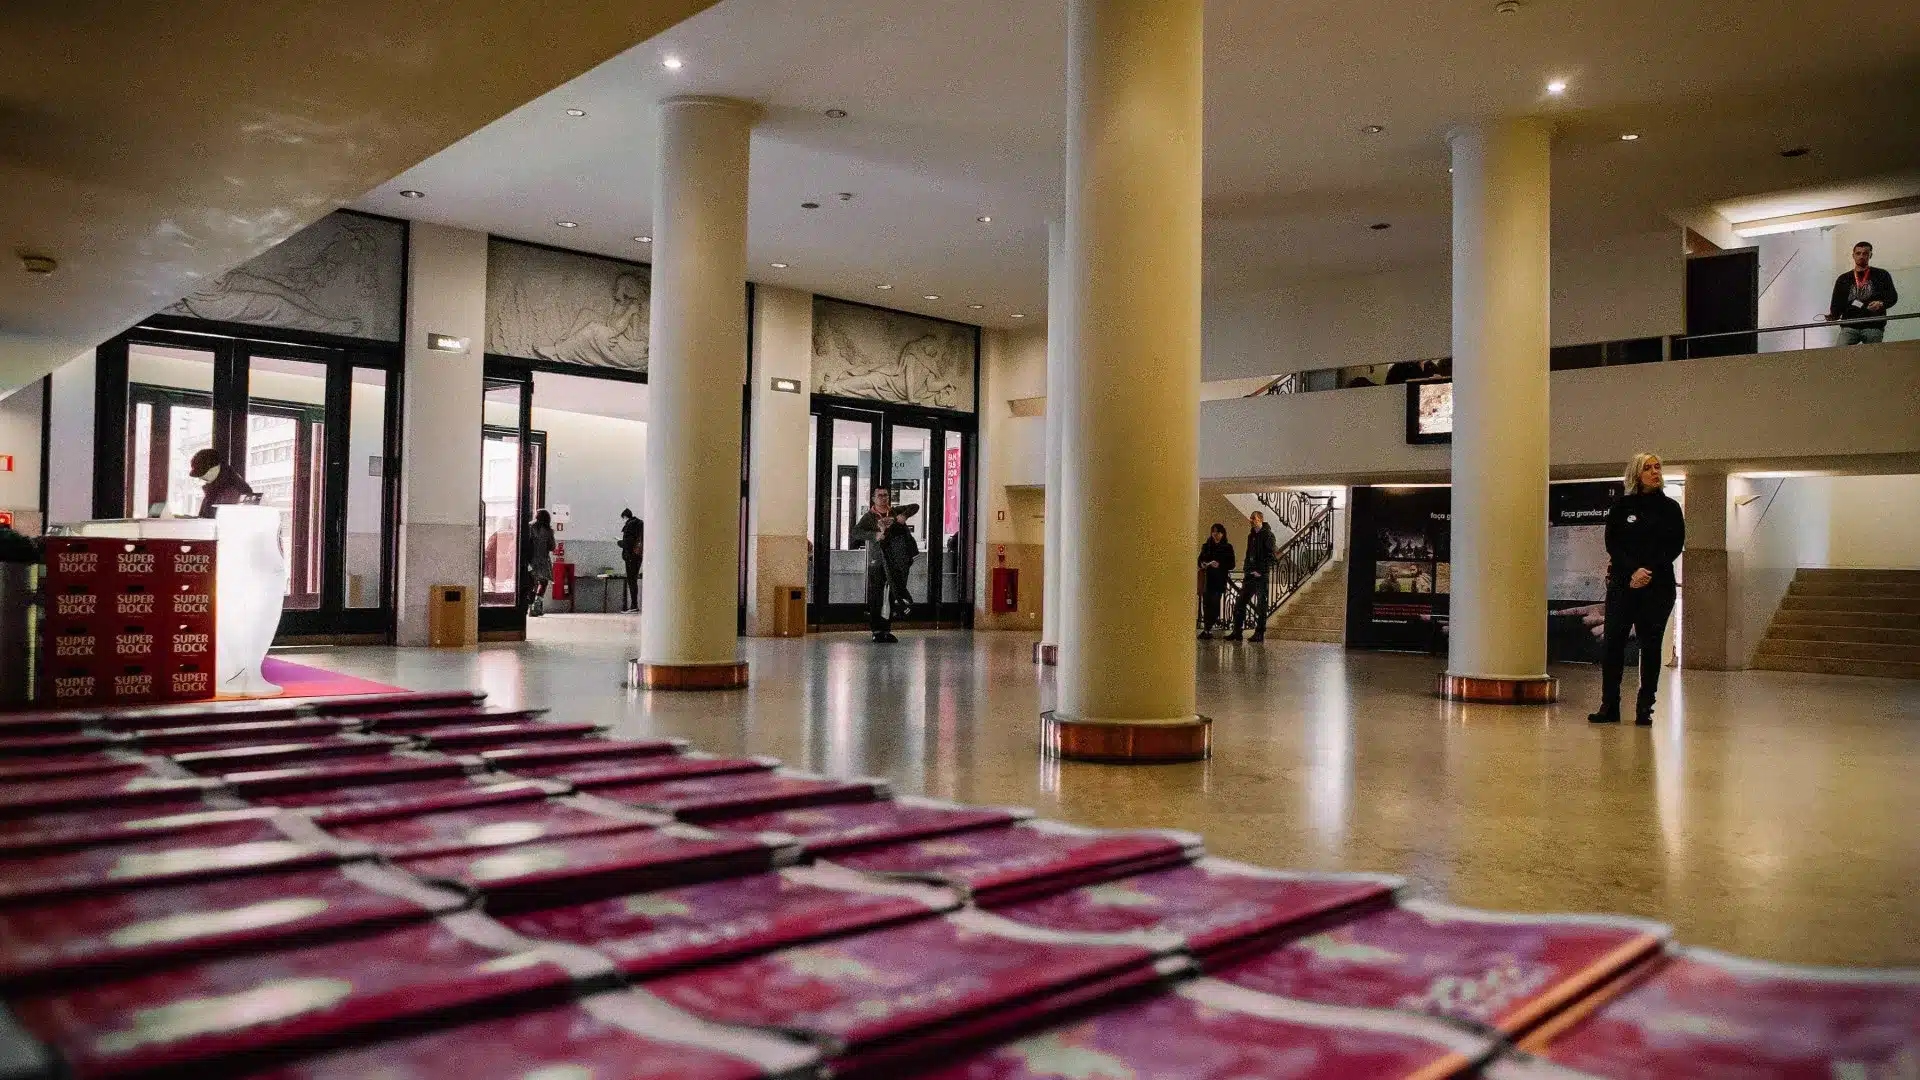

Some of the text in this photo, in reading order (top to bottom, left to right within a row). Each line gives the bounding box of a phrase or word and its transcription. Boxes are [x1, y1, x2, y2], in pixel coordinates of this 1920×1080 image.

[1576, 509, 1602, 518] grandes
[58, 553, 98, 562] SUPER
[118, 554, 155, 563] SUPER
[174, 554, 210, 563] SUPER
[59, 563, 96, 572] BOCK
[118, 564, 153, 572] BOCK
[175, 564, 208, 573] BOCK
[57, 595, 97, 603] SUPER
[117, 595, 154, 603] SUPER
[173, 594, 209, 603] SUPER
[58, 604, 95, 614] BOCK
[118, 604, 152, 613] BOCK
[174, 604, 208, 612] BOCK
[56, 636, 96, 646] SUPER
[116, 634, 153, 644] SUPER
[173, 634, 208, 643] SUPER
[56, 646, 95, 656] BOCK
[117, 644, 152, 653] BOCK
[174, 644, 207, 652] BOCK
[55, 676, 96, 687] SUPER
[114, 675, 152, 685] SUPER
[172, 673, 208, 682] SUPER
[116, 685, 150, 694] BOCK
[173, 682, 207, 692] BOCK
[56, 687, 93, 697] BOCK
